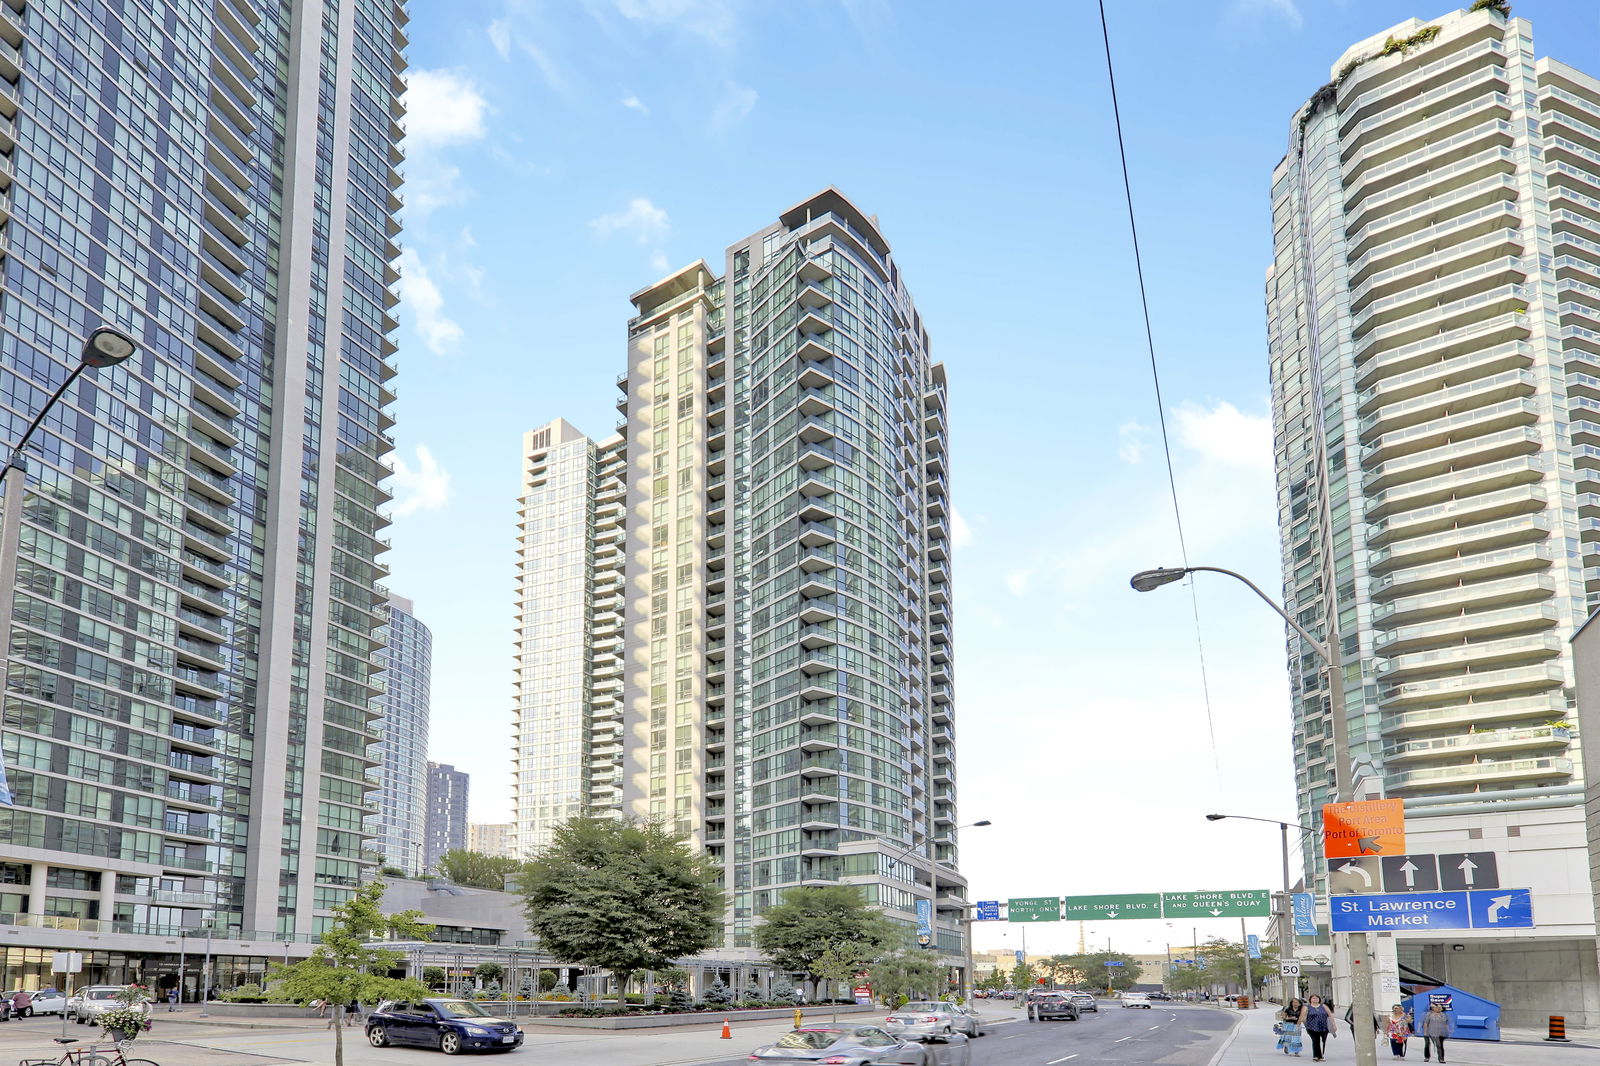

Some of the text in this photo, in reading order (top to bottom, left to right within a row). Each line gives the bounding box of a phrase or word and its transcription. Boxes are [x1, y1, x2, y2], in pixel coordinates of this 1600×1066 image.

[1328, 806, 1347, 814] The
[1339, 815, 1387, 826] Port Area
[1325, 827, 1403, 839] Port of Toronto
[1341, 900, 1457, 912] St. Lawrence
[1368, 914, 1429, 926] Market
[1283, 966, 1298, 974] 50
